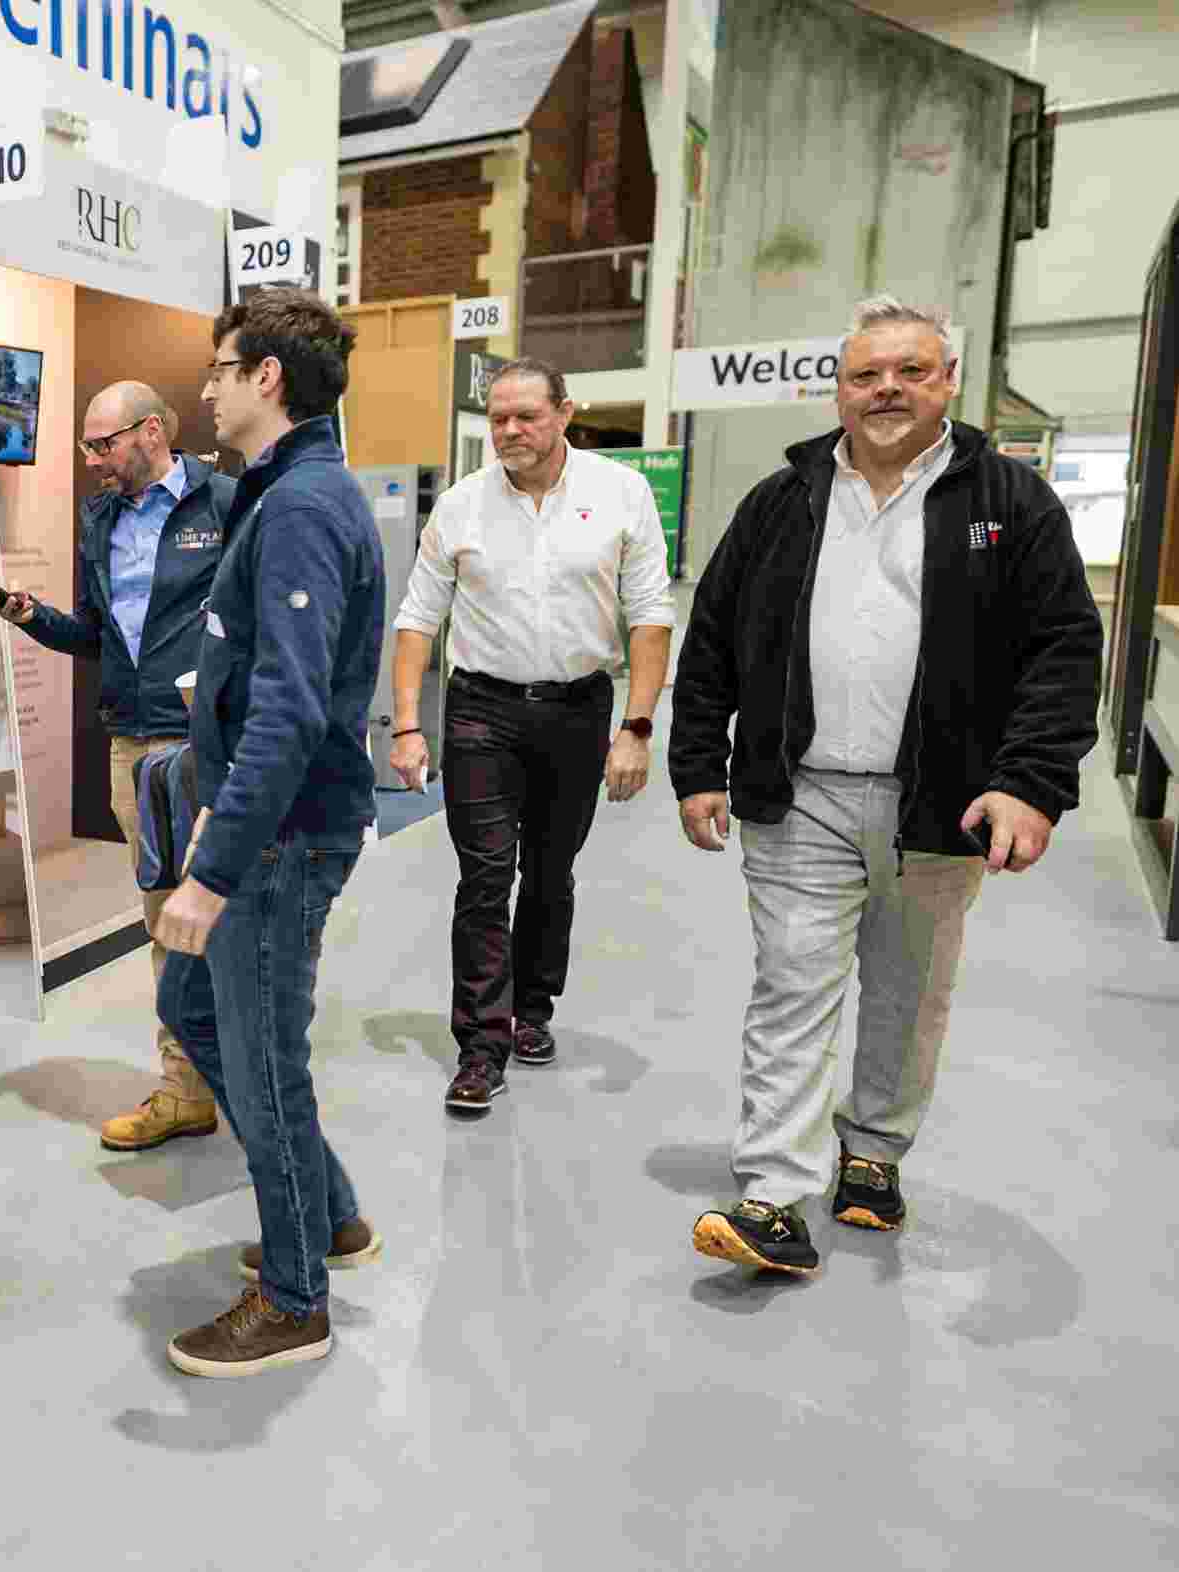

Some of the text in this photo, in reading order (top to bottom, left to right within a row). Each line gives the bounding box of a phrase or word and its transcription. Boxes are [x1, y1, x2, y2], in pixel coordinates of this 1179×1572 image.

[77, 187, 141, 251] RHC
[242, 239, 290, 271] 209
[461, 305, 500, 328] 208
[711, 349, 838, 386] Welco
[200, 531, 223, 545] PLA
